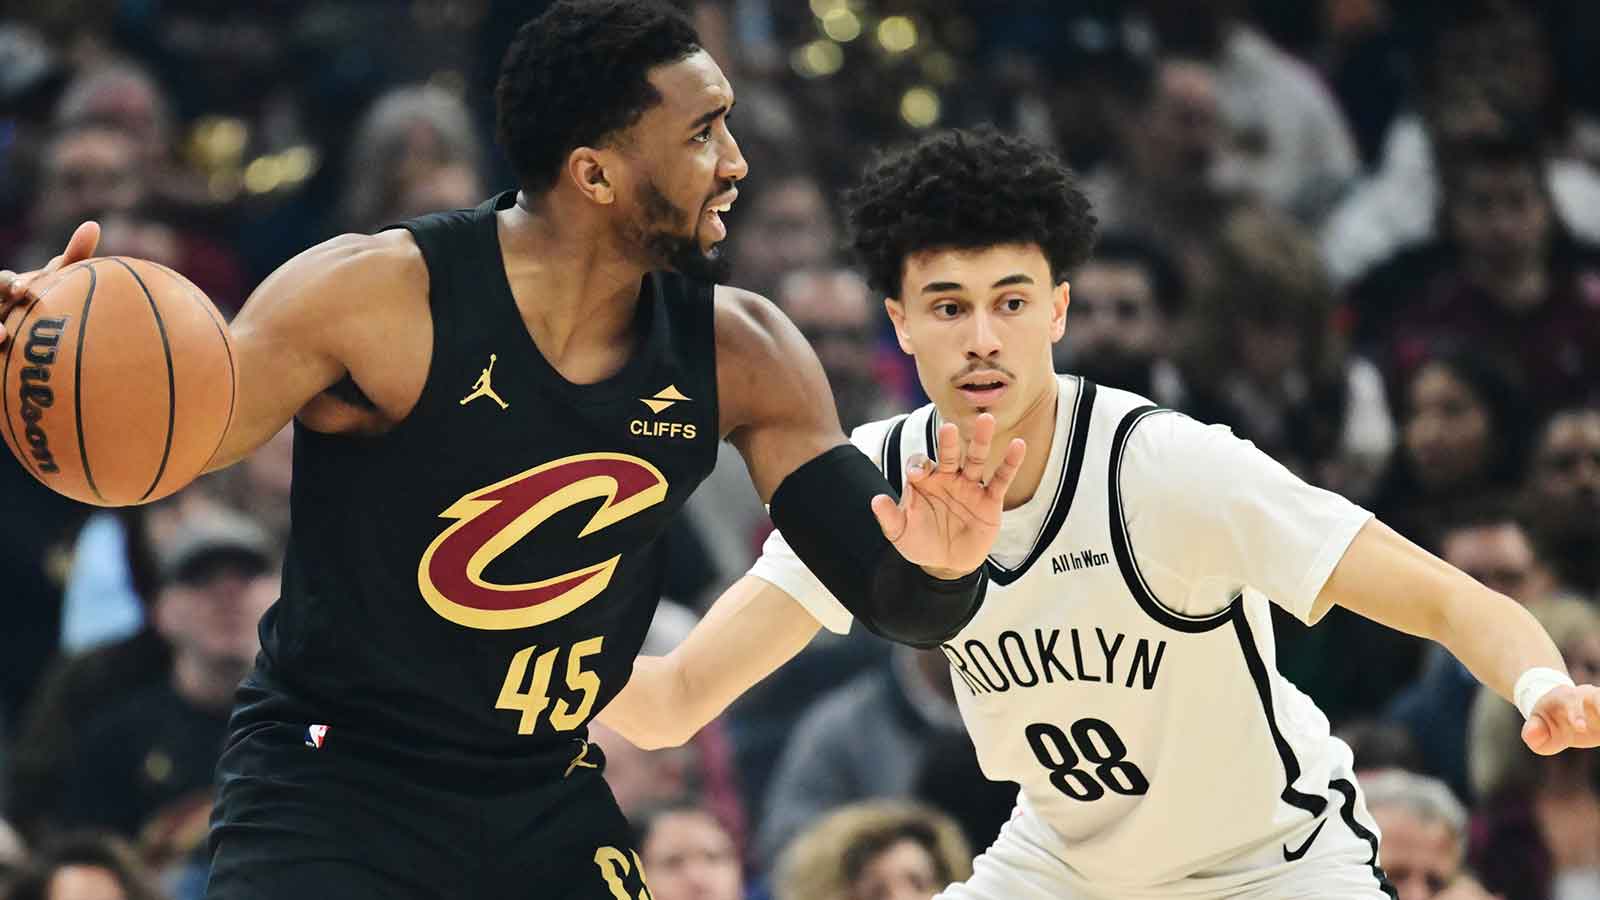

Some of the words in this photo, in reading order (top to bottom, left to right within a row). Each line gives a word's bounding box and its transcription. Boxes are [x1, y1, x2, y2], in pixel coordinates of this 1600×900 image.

[20, 316, 68, 474] Wilson
[630, 420, 697, 439] CLIFFS
[418, 452, 669, 630] C
[1052, 554, 1070, 575] All
[1070, 553, 1083, 570] In
[1081, 549, 1109, 568] Won
[495, 636, 604, 735] 45
[938, 627, 1167, 696] ROOKLYN
[1025, 718, 1150, 802] 88
